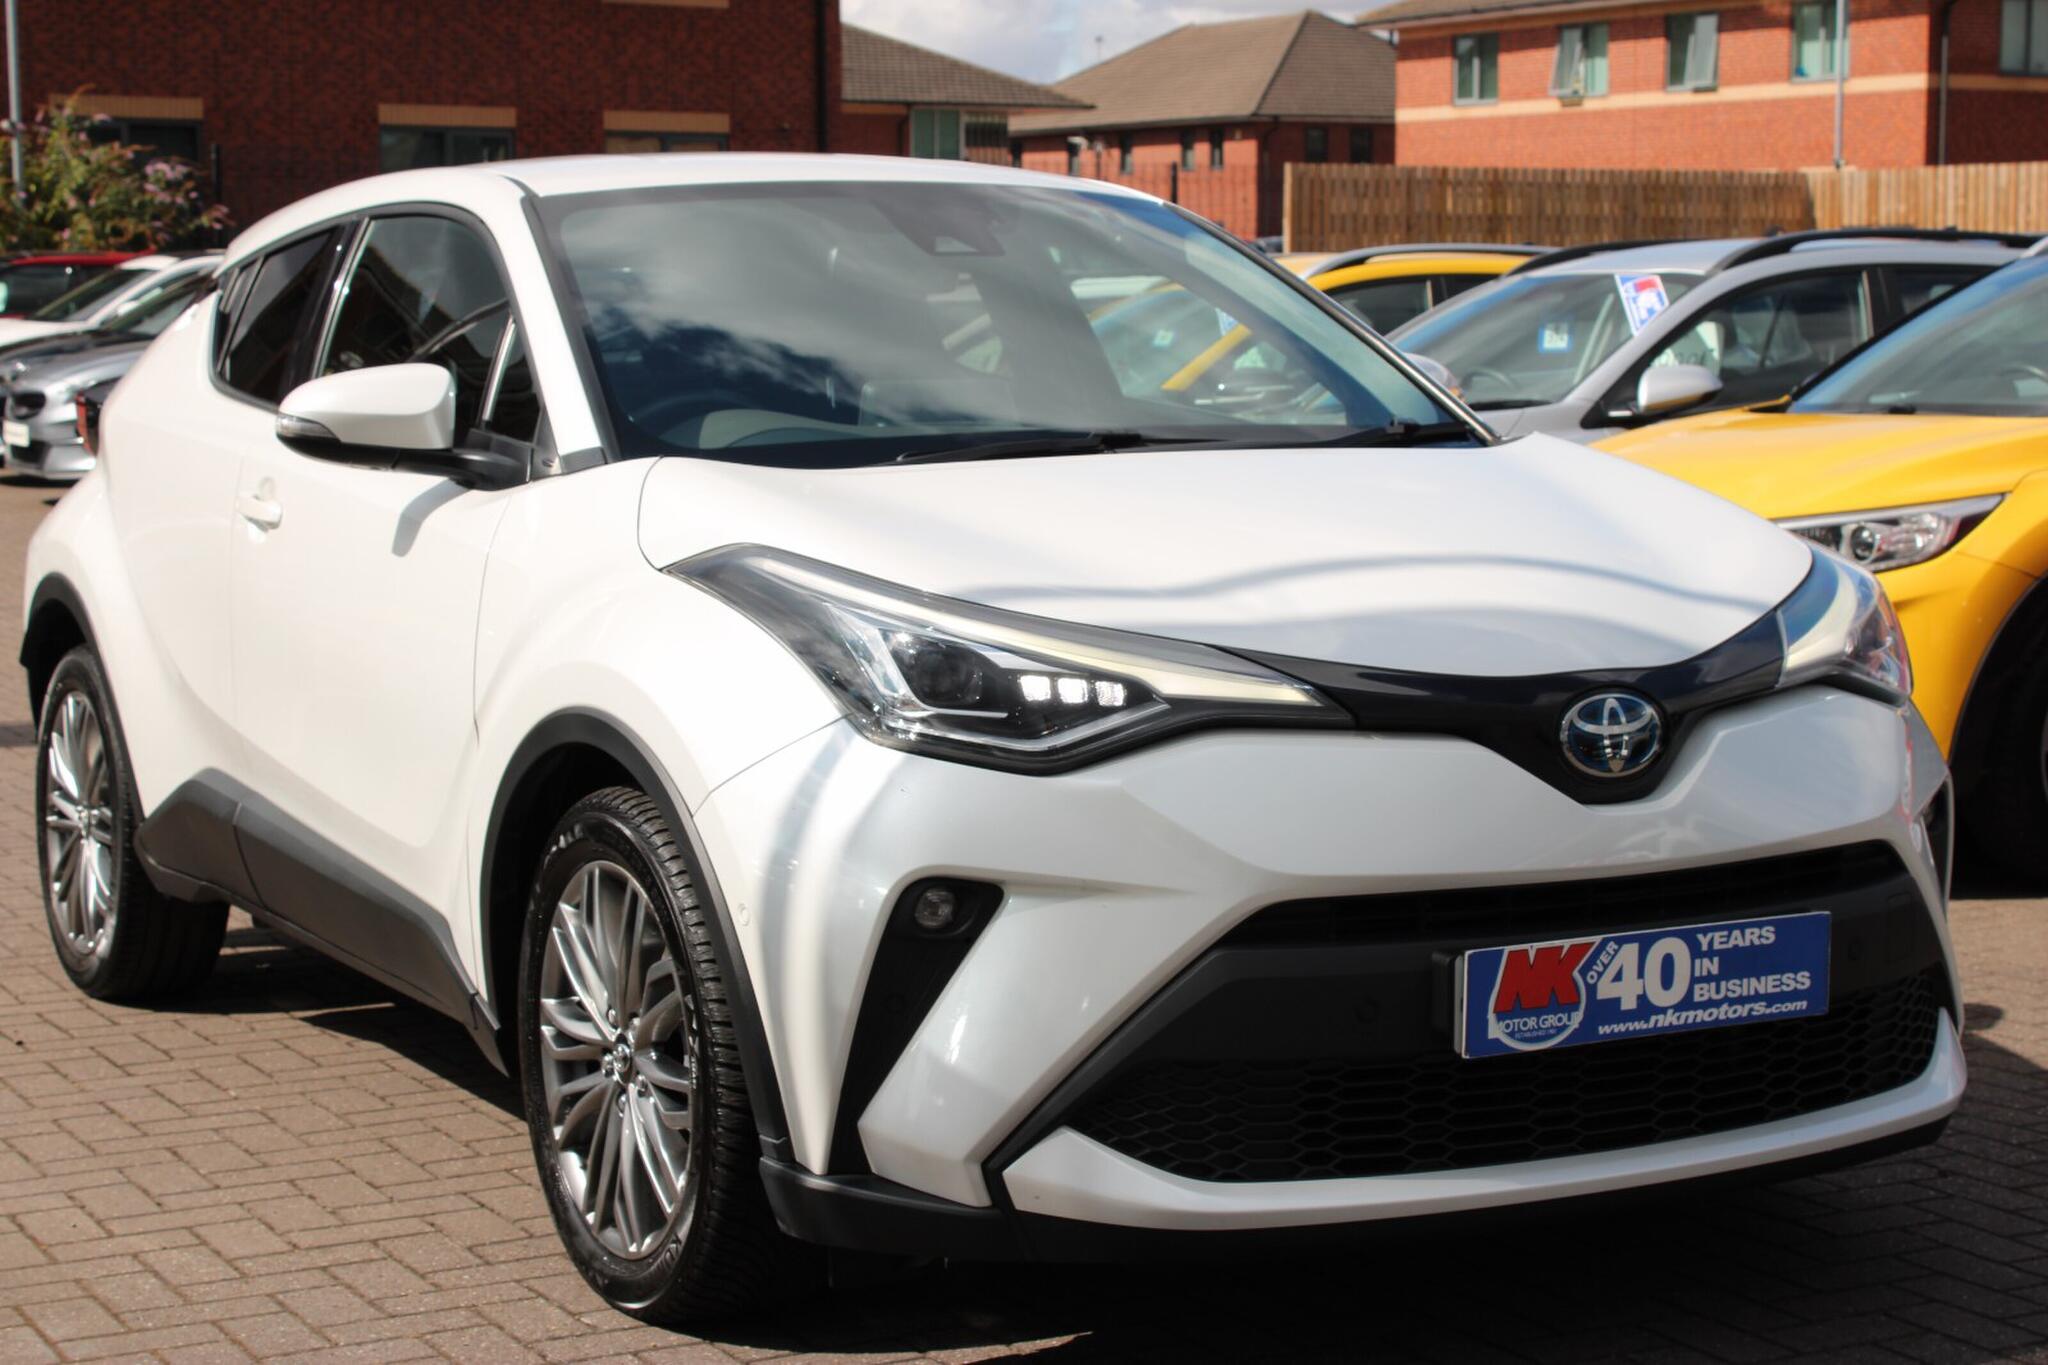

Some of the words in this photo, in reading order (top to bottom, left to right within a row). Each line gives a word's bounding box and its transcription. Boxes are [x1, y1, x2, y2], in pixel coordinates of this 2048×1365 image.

[1696, 926, 1776, 951] YEARS
[1493, 942, 1597, 1014] NK
[1586, 941, 1619, 984] OVER
[1596, 936, 1692, 1010] 40
[1694, 957, 1719, 977] IN
[1693, 971, 1811, 1002] BUSINESS
[1598, 1000, 1808, 1035] www.nkmotors.com
